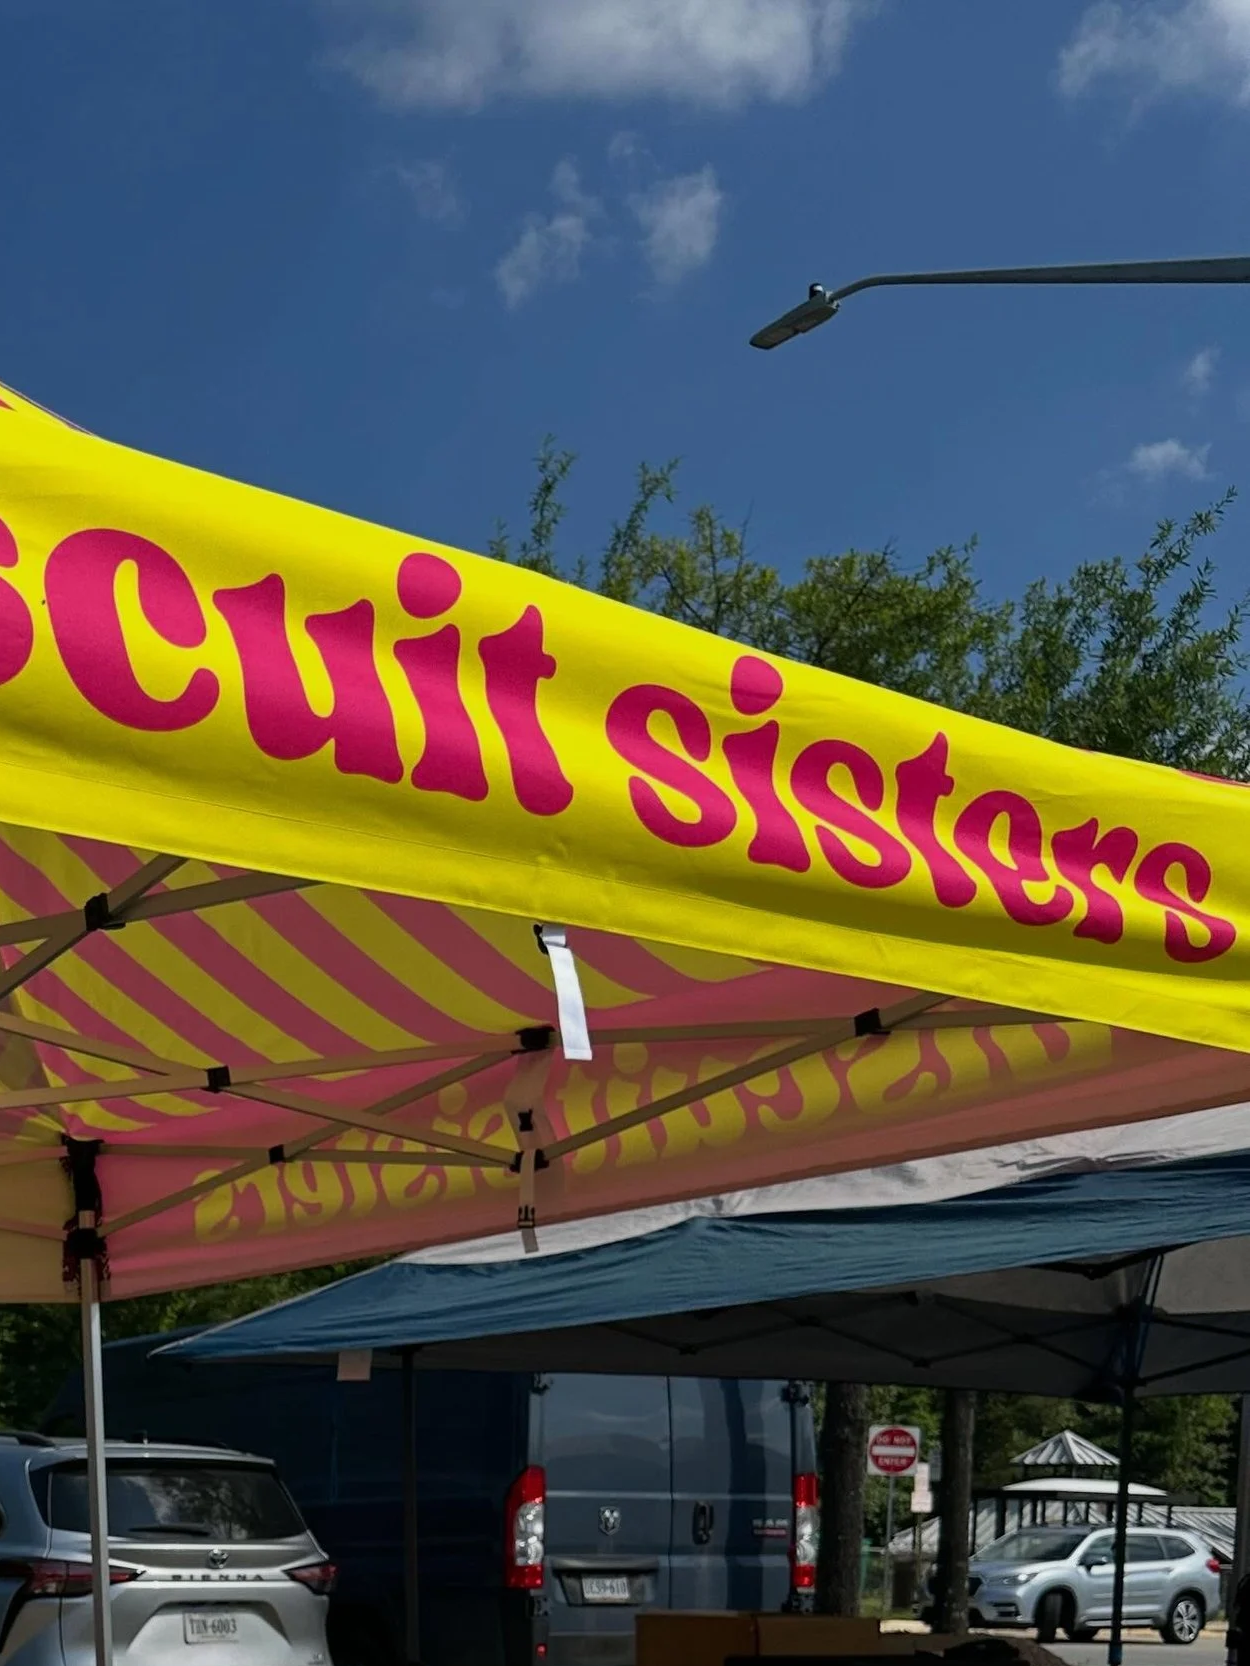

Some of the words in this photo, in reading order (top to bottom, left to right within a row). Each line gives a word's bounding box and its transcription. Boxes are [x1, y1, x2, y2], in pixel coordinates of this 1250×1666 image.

[606, 655, 1236, 963] sisters
[876, 1435, 890, 1445] DO
[893, 1435, 913, 1446] NOT
[878, 1457, 908, 1467] ENTER
